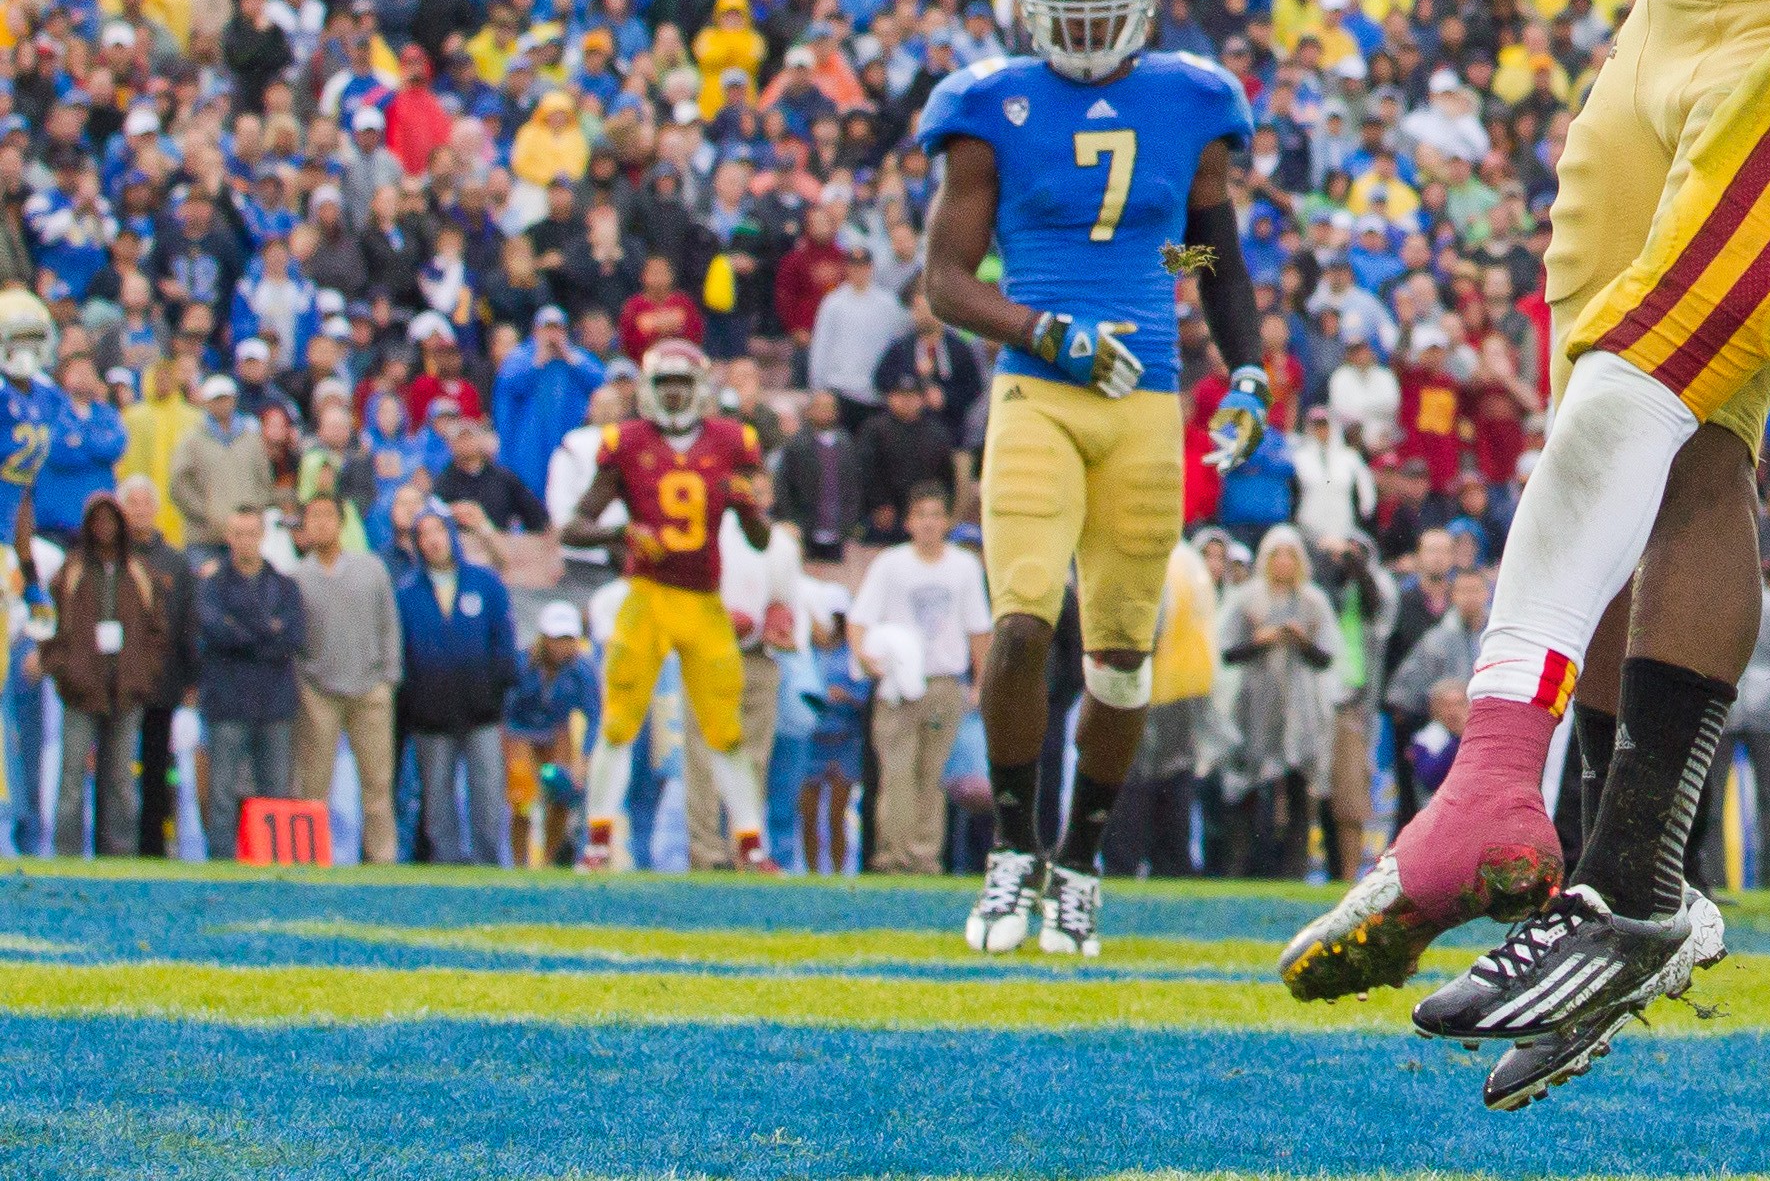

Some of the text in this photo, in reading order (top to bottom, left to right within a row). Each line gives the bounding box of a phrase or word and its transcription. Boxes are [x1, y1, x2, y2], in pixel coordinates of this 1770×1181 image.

[1073, 128, 1137, 241] 7
[658, 471, 708, 552] 9
[264, 812, 316, 863] 10
